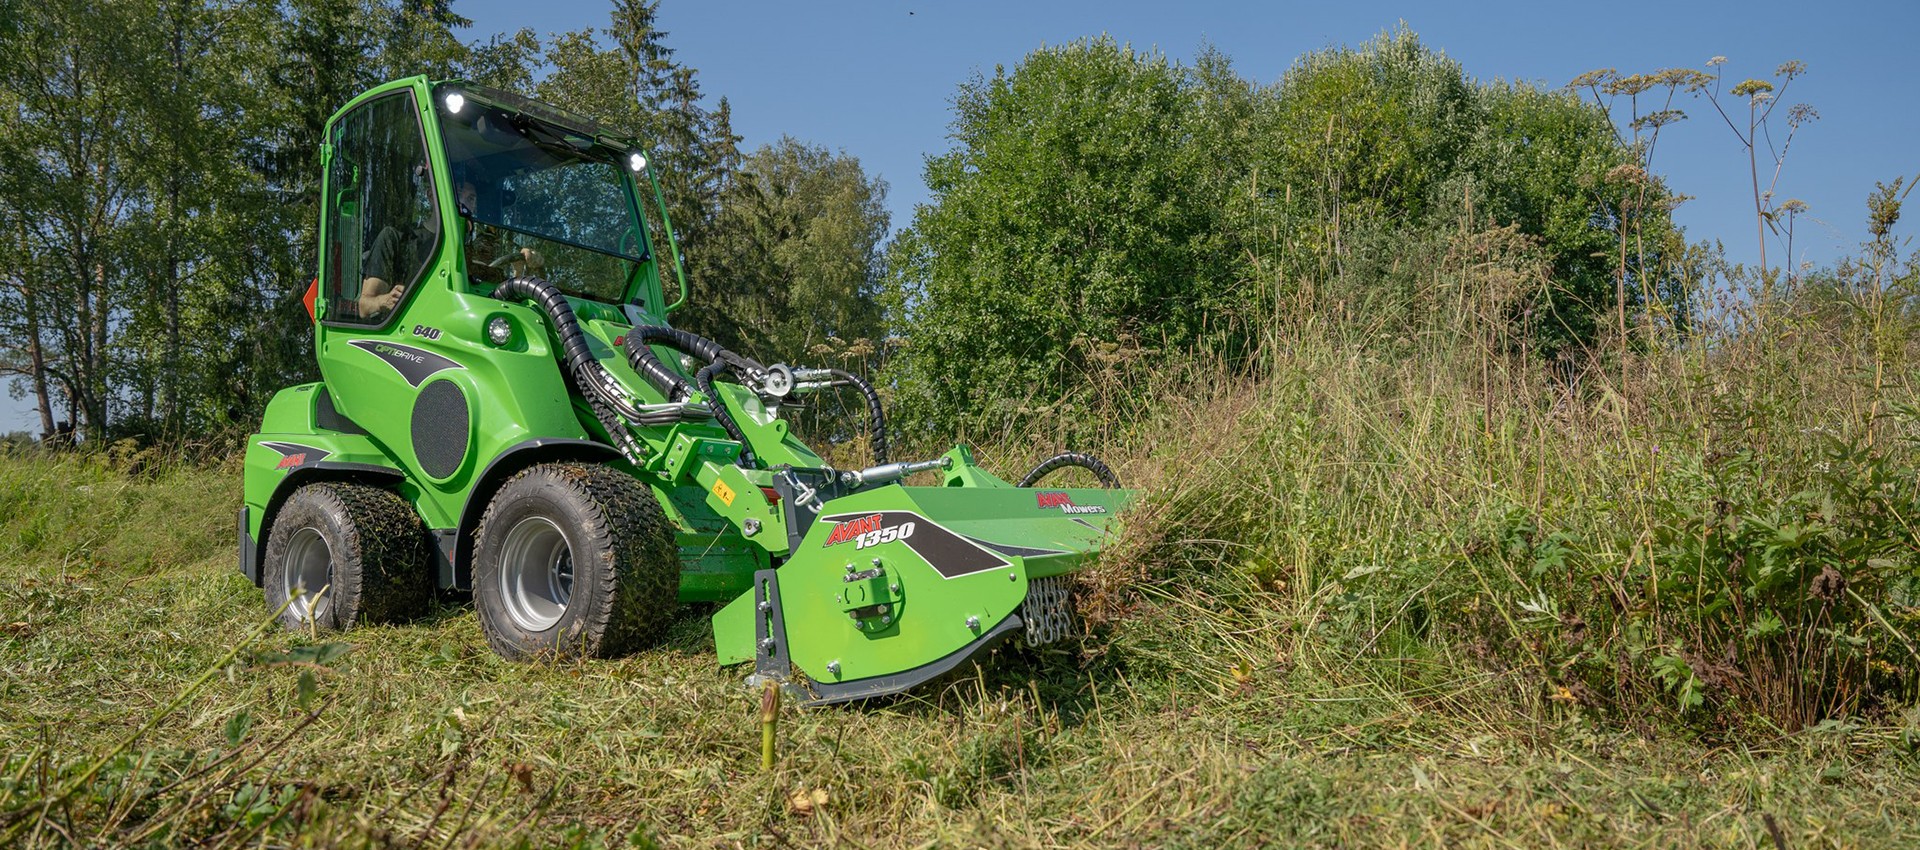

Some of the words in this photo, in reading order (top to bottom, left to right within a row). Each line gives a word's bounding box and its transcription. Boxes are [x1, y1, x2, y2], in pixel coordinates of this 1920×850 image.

[375, 343, 425, 364] OPTIDRIVE
[1060, 503, 1107, 514] Mowers
[823, 513, 883, 548] AVANT
[855, 521, 916, 550] 1350
